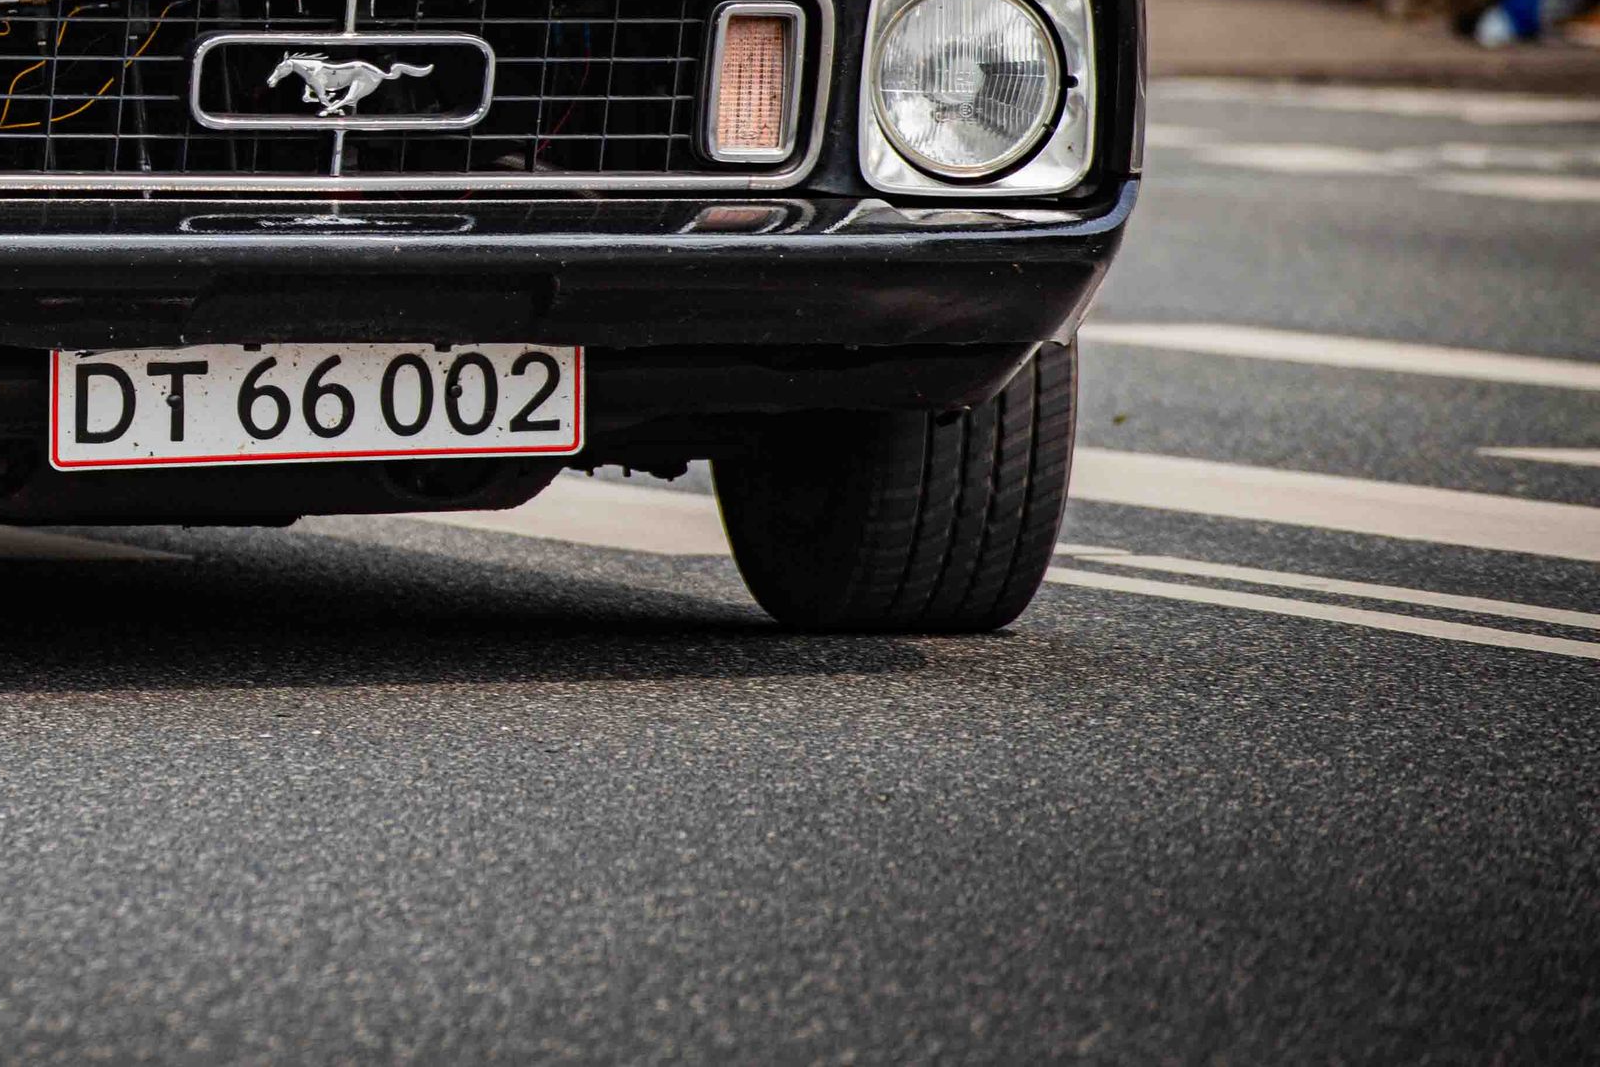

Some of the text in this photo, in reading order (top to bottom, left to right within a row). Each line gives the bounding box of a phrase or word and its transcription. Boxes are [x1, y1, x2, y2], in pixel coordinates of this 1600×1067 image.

[76, 351, 561, 444] DT 66 002
